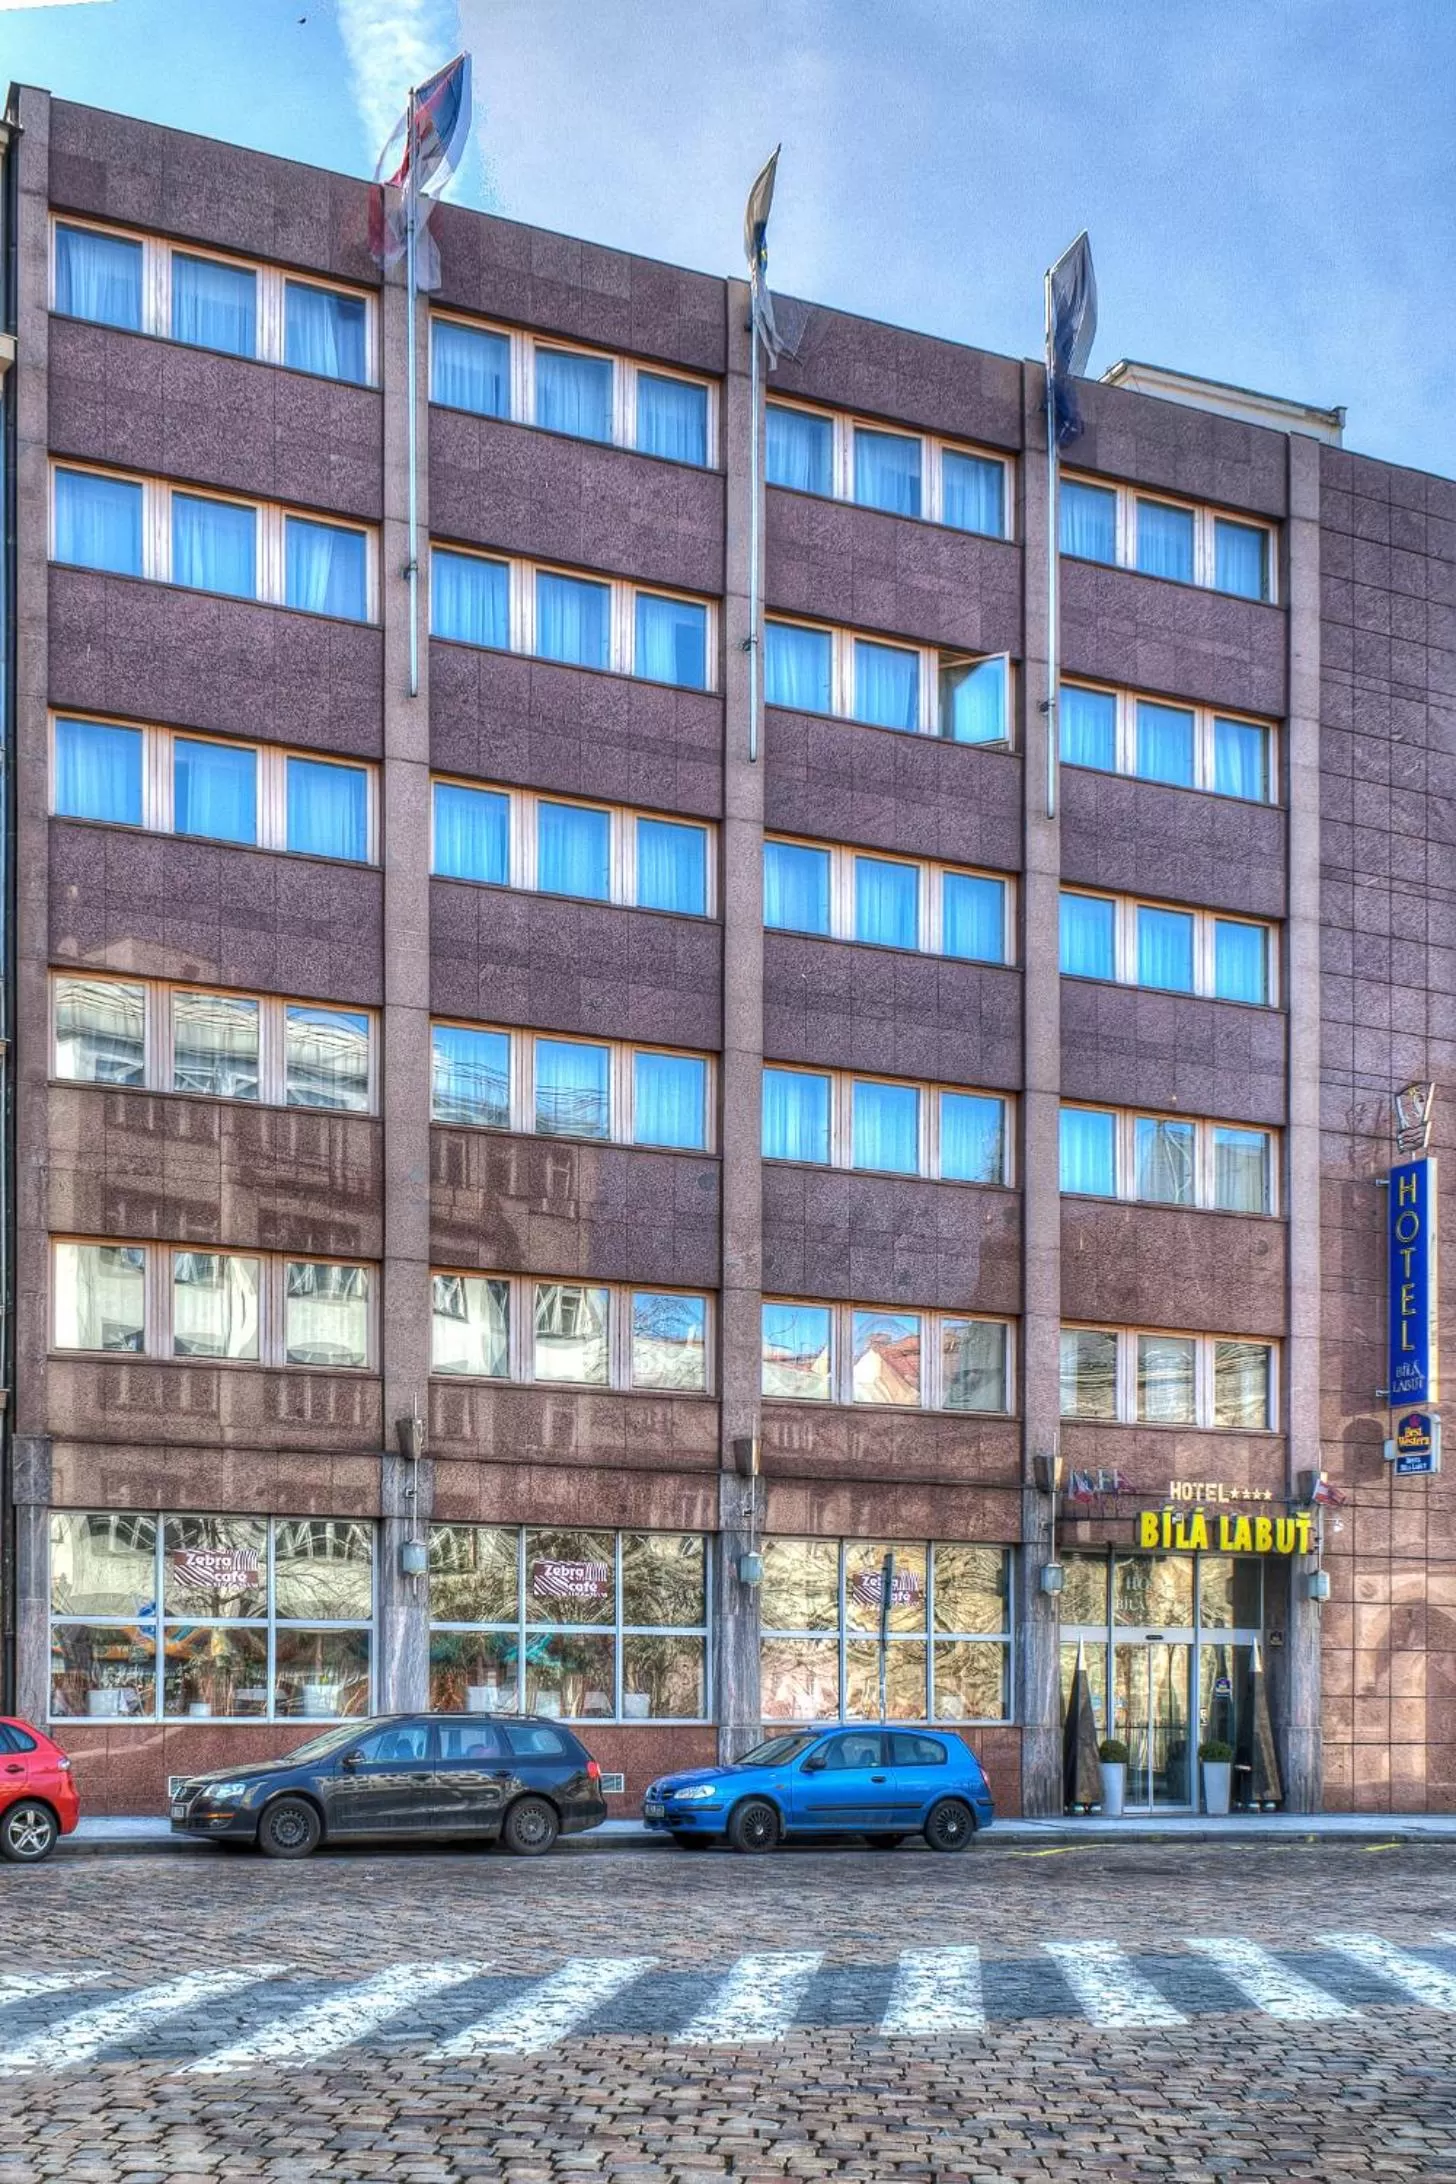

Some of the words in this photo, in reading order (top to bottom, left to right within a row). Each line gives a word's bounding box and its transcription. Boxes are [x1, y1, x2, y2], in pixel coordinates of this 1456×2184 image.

[1396, 1172, 1419, 1351] HOTEL
[1170, 1480, 1229, 1502] HOTEL
[1140, 1504, 1208, 1549] BÍLÁ
[1219, 1511, 1312, 1554] LABUŤ
[186, 1553, 231, 1566] Zebra
[214, 1571, 247, 1582] café
[543, 1564, 585, 1577] Zebra
[568, 1581, 597, 1592] café
[887, 1592, 910, 1602] afé
